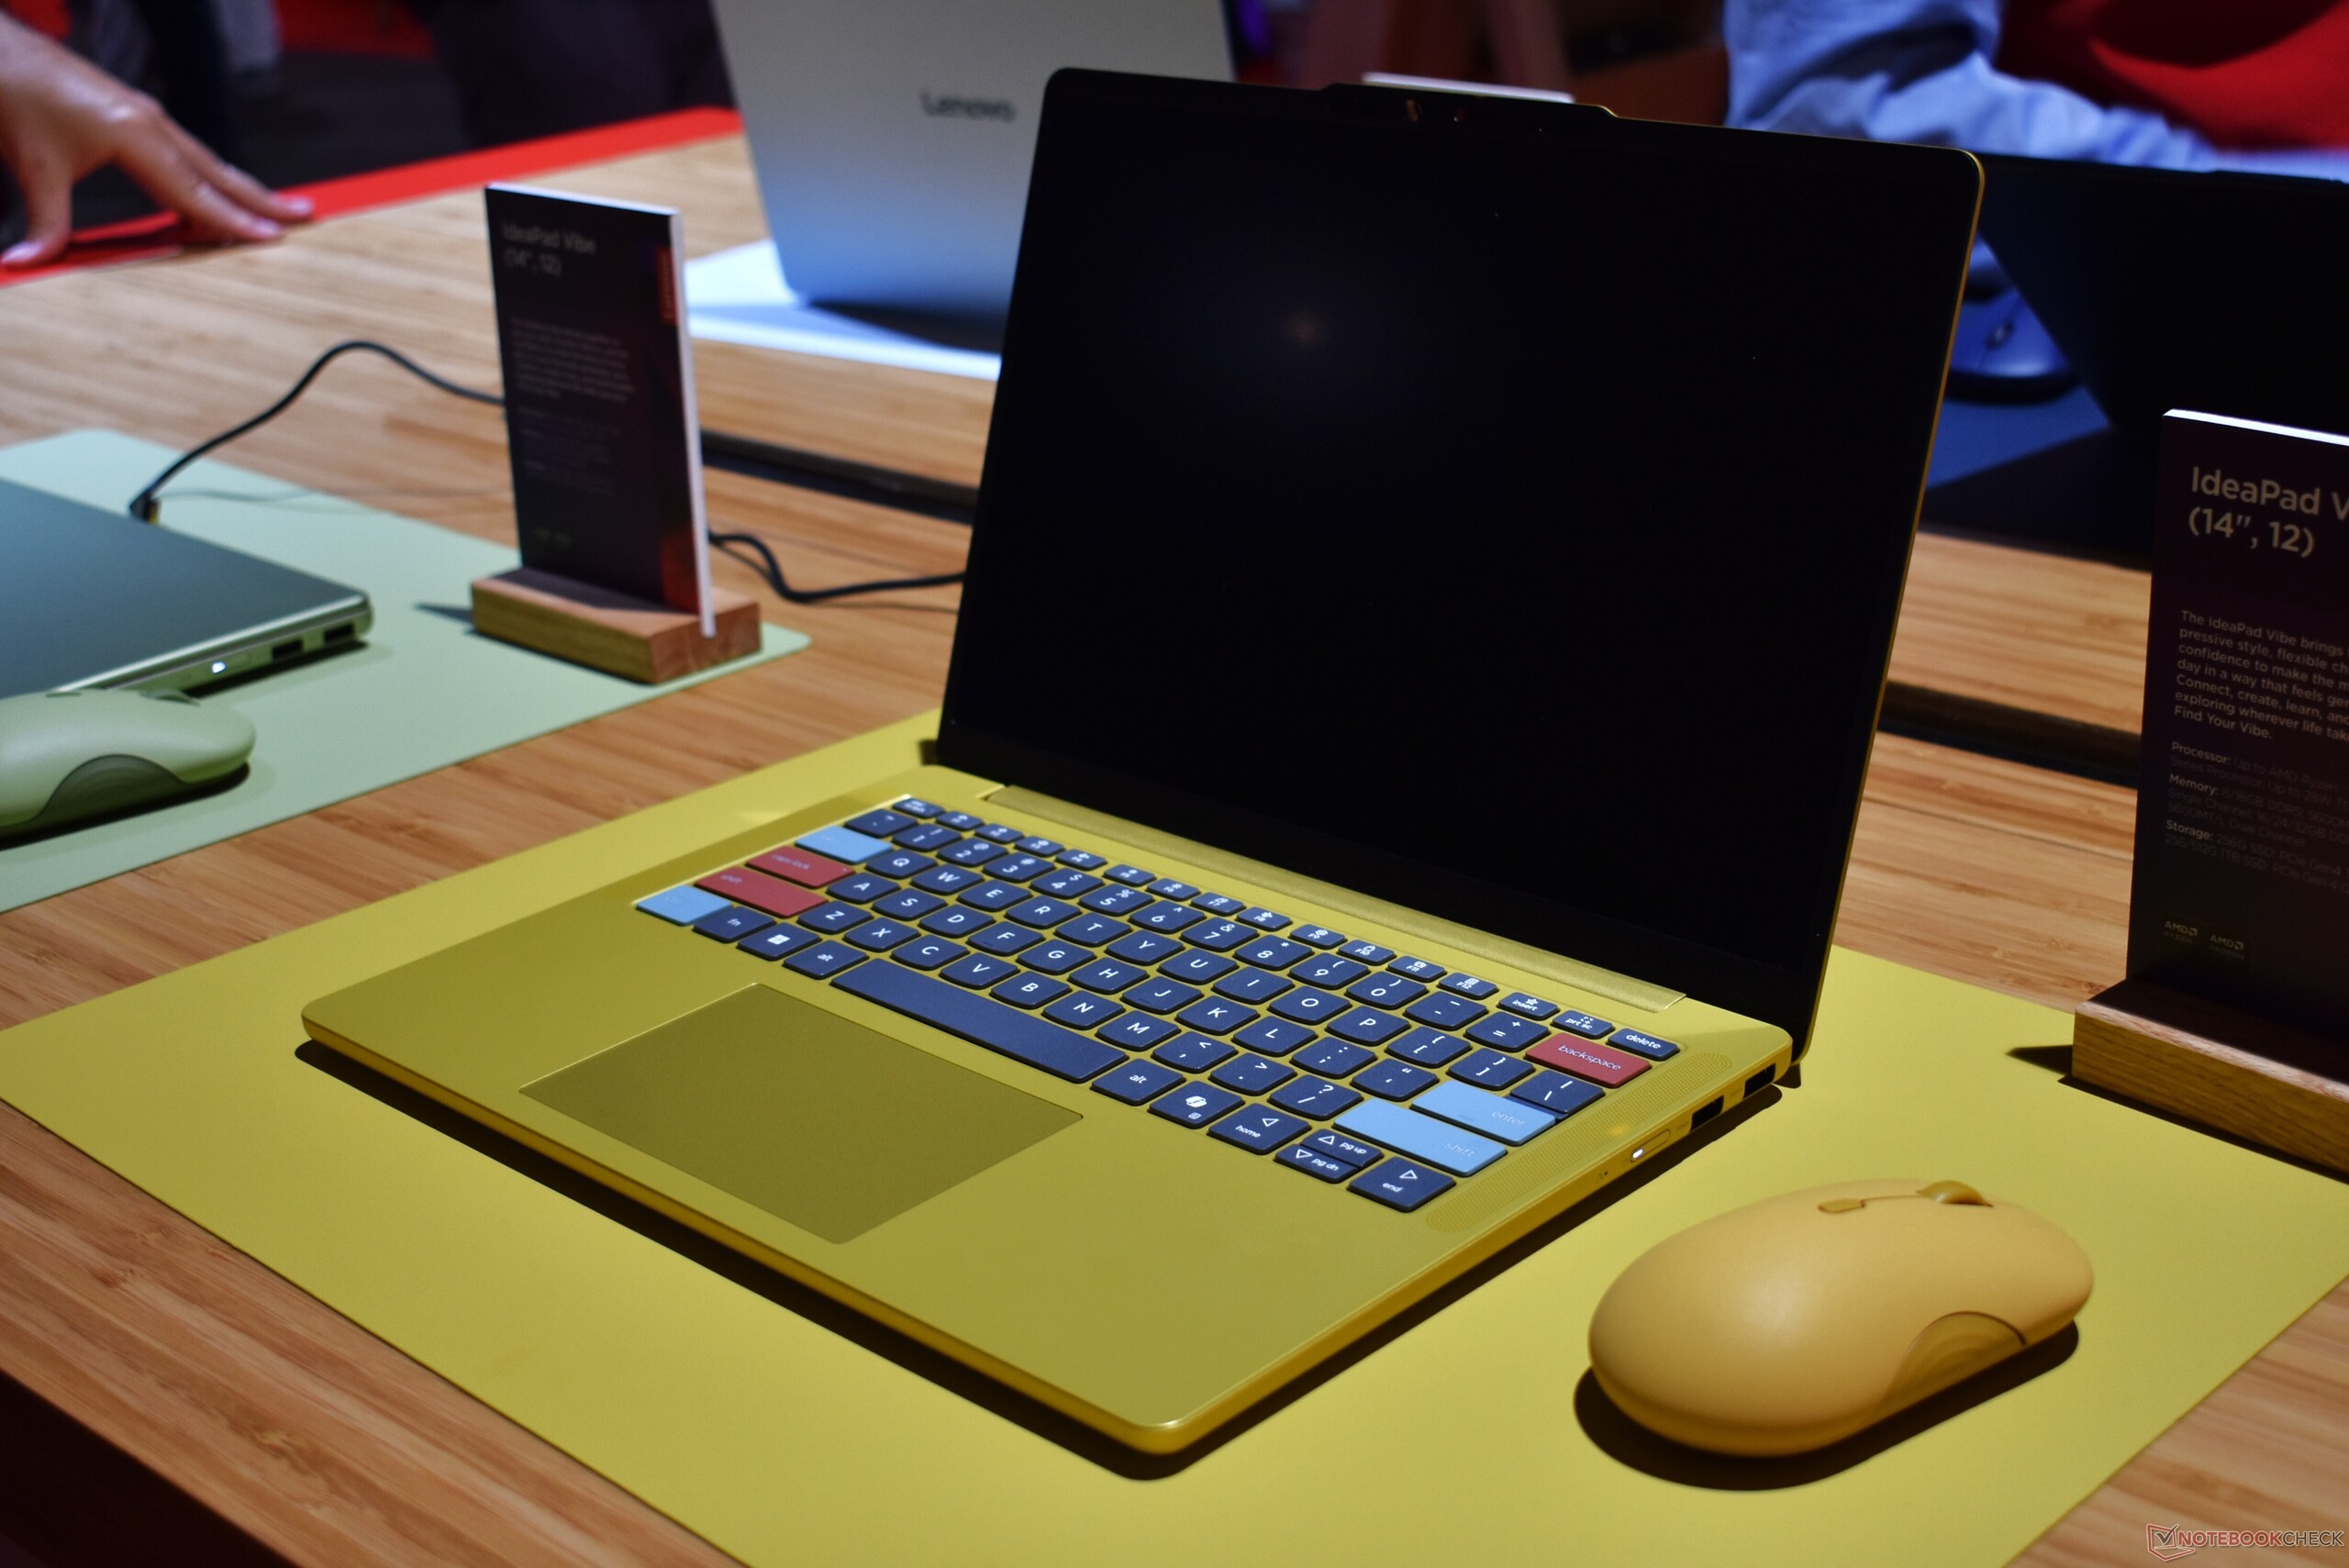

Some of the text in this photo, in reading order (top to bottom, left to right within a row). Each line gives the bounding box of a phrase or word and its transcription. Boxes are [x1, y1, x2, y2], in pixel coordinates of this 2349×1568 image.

[2191, 465, 2321, 516] IdeaPad
[2188, 506, 2315, 559] (14", 12)
[2180, 609, 2343, 657] The IdeaPad Vibe brings
[2179, 628, 2233, 649] pressive
[2277, 648, 2327, 670] flexible
[2178, 644, 2251, 669] confidence
[2254, 660, 2268, 673] to
[2272, 665, 2309, 683] make
[2312, 673, 2334, 688] the
[2176, 673, 2233, 699] Connect,
[2177, 658, 2201, 675] day
[2204, 662, 2216, 677] in
[2220, 670, 2228, 679] a
[2231, 673, 2257, 689] way
[2261, 678, 2288, 695] that
[2291, 684, 2323, 703] feels
[2175, 692, 2235, 716] exploring
[2239, 706, 2299, 728] wherever
[2302, 720, 2322, 735] life
[2174, 705, 2272, 740] Find Your Vibe.
[2171, 741, 2231, 765] Processor:
[2169, 773, 2219, 796] Memory:
[2166, 819, 2213, 841] Storage:
[892, 857, 910, 868] Q
[937, 871, 961, 884] W
[852, 882, 871, 892] A
[985, 888, 1004, 899] E
[900, 897, 918, 907] S
[1098, 896, 1113, 906] 5
[824, 910, 845, 921] Z
[1033, 905, 1052, 916] R
[946, 913, 965, 924] D
[1151, 914, 1166, 923] 6
[871, 927, 893, 939] X
[1086, 922, 1104, 932] T
[996, 931, 1016, 940] F
[1203, 930, 1221, 940] 7
[2164, 920, 2234, 948] AMD AMD
[920, 945, 940, 956] C
[1138, 940, 1156, 950] Y
[1047, 950, 1066, 960] G
[1256, 950, 1275, 959] 8
[972, 962, 991, 973] V
[1189, 958, 1209, 969] U
[1097, 967, 1119, 979] H
[1313, 968, 1330, 977] 9
[1020, 982, 1040, 993] B
[1153, 989, 1173, 997] J
[1073, 1001, 1095, 1014] N
[1207, 1006, 1229, 1018] K
[1126, 1021, 1151, 1035] M
[1358, 1018, 1377, 1027] P
[1264, 1028, 1279, 1040] L
[1625, 1033, 1662, 1050] delete
[1558, 1045, 1621, 1070] backspace
[1129, 1074, 1148, 1084] alt
[1491, 1110, 1525, 1126] enter
[1234, 1124, 1262, 1139] home
[1444, 1143, 1475, 1157] shift
[1382, 1182, 1404, 1193] end
